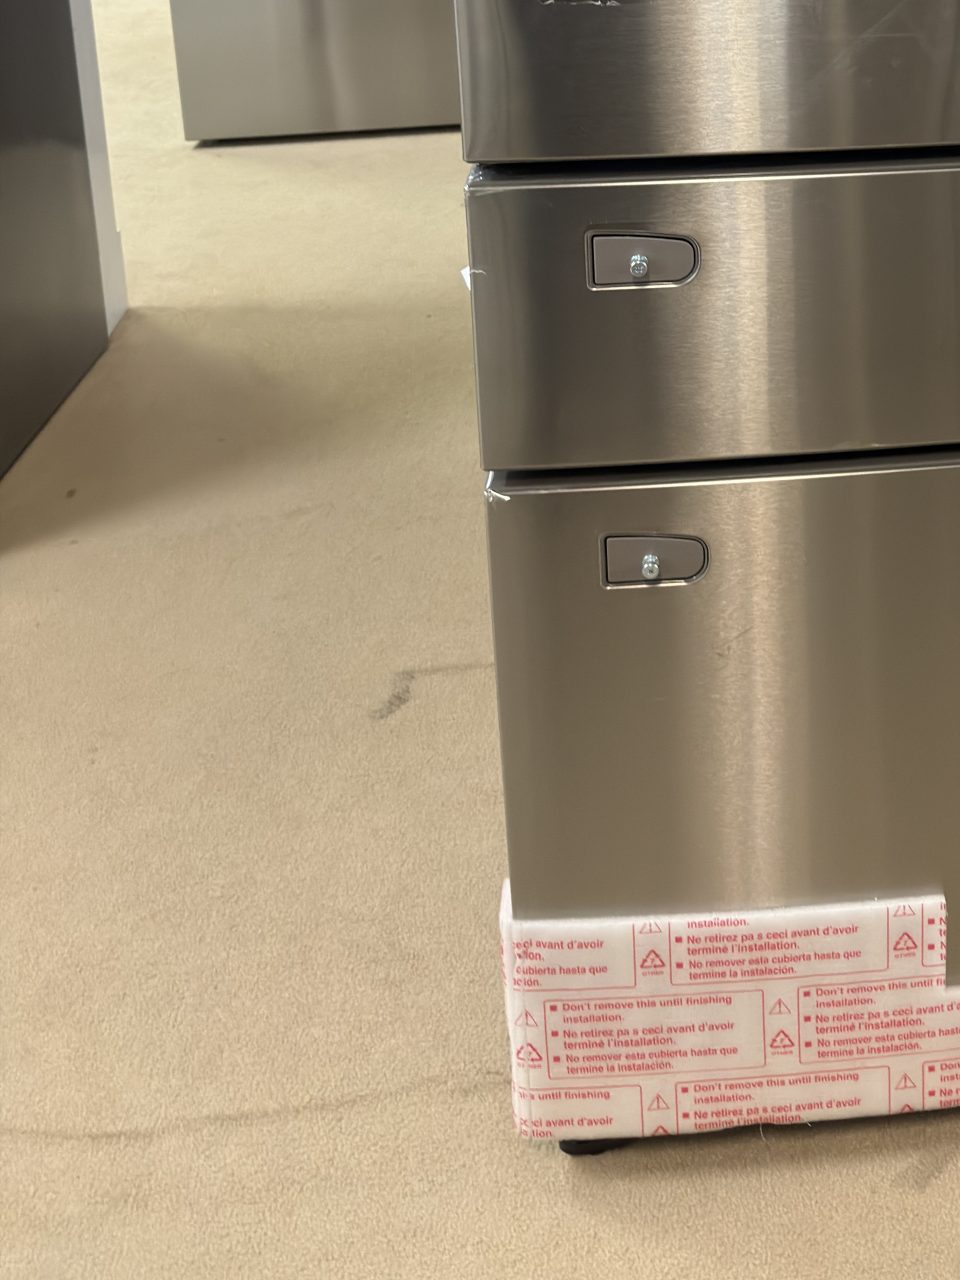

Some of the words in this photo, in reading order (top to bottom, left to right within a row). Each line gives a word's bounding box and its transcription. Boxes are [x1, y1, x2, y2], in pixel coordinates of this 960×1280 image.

[562, 1001, 591, 1011] Don't
[594, 1001, 633, 1010] remove
[637, 998, 656, 1008] this
[660, 997, 682, 1007] until
[686, 996, 732, 1007] finishing
[563, 1013, 624, 1024] installation.
[563, 1029, 578, 1038] Ne
[580, 1028, 614, 1037] retirez
[617, 1028, 630, 1038] pa
[642, 1024, 664, 1034] ceci
[667, 1024, 695, 1033] avant
[699, 1021, 734, 1032] d'avoir
[564, 1038, 604, 1049] terminé
[608, 1036, 676, 1047] l'installation.
[566, 1054, 580, 1063] No
[582, 1053, 622, 1062] remover
[625, 1051, 646, 1060] esta
[649, 1049, 688, 1059] cubierta
[691, 1047, 717, 1057] hasta
[720, 1047, 737, 1058] que
[567, 1064, 603, 1074] termine
[606, 1063, 615, 1072] la
[618, 1060, 673, 1072] instalación.
